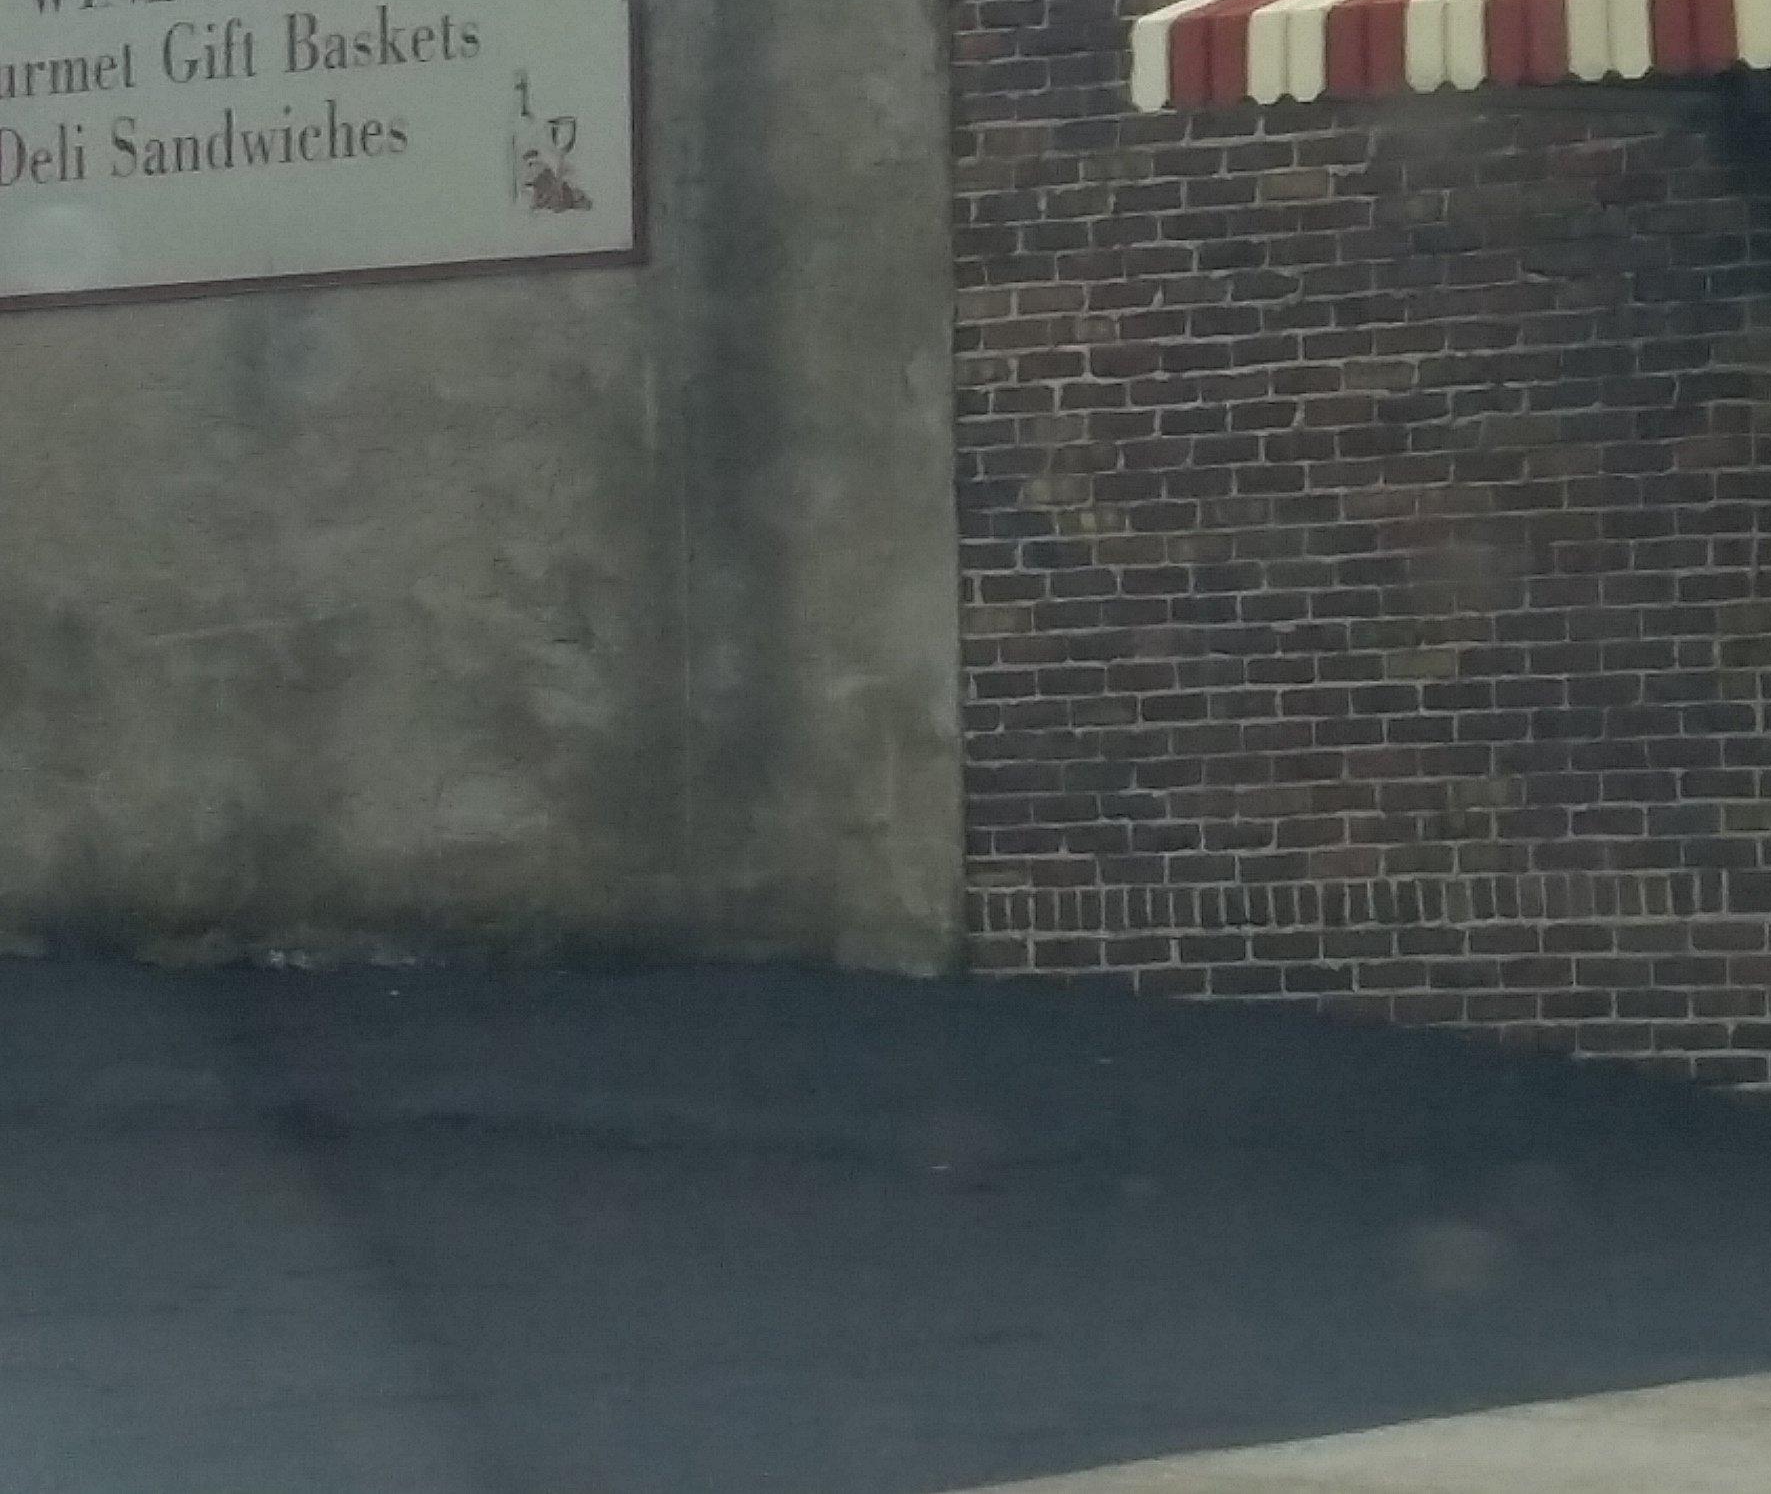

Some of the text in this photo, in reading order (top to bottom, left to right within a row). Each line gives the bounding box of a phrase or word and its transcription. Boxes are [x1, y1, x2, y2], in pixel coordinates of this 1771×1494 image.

[163, 16, 256, 84] Gift
[284, 4, 483, 75] Baskets
[0, 99, 410, 187] Deli Sandwiches
